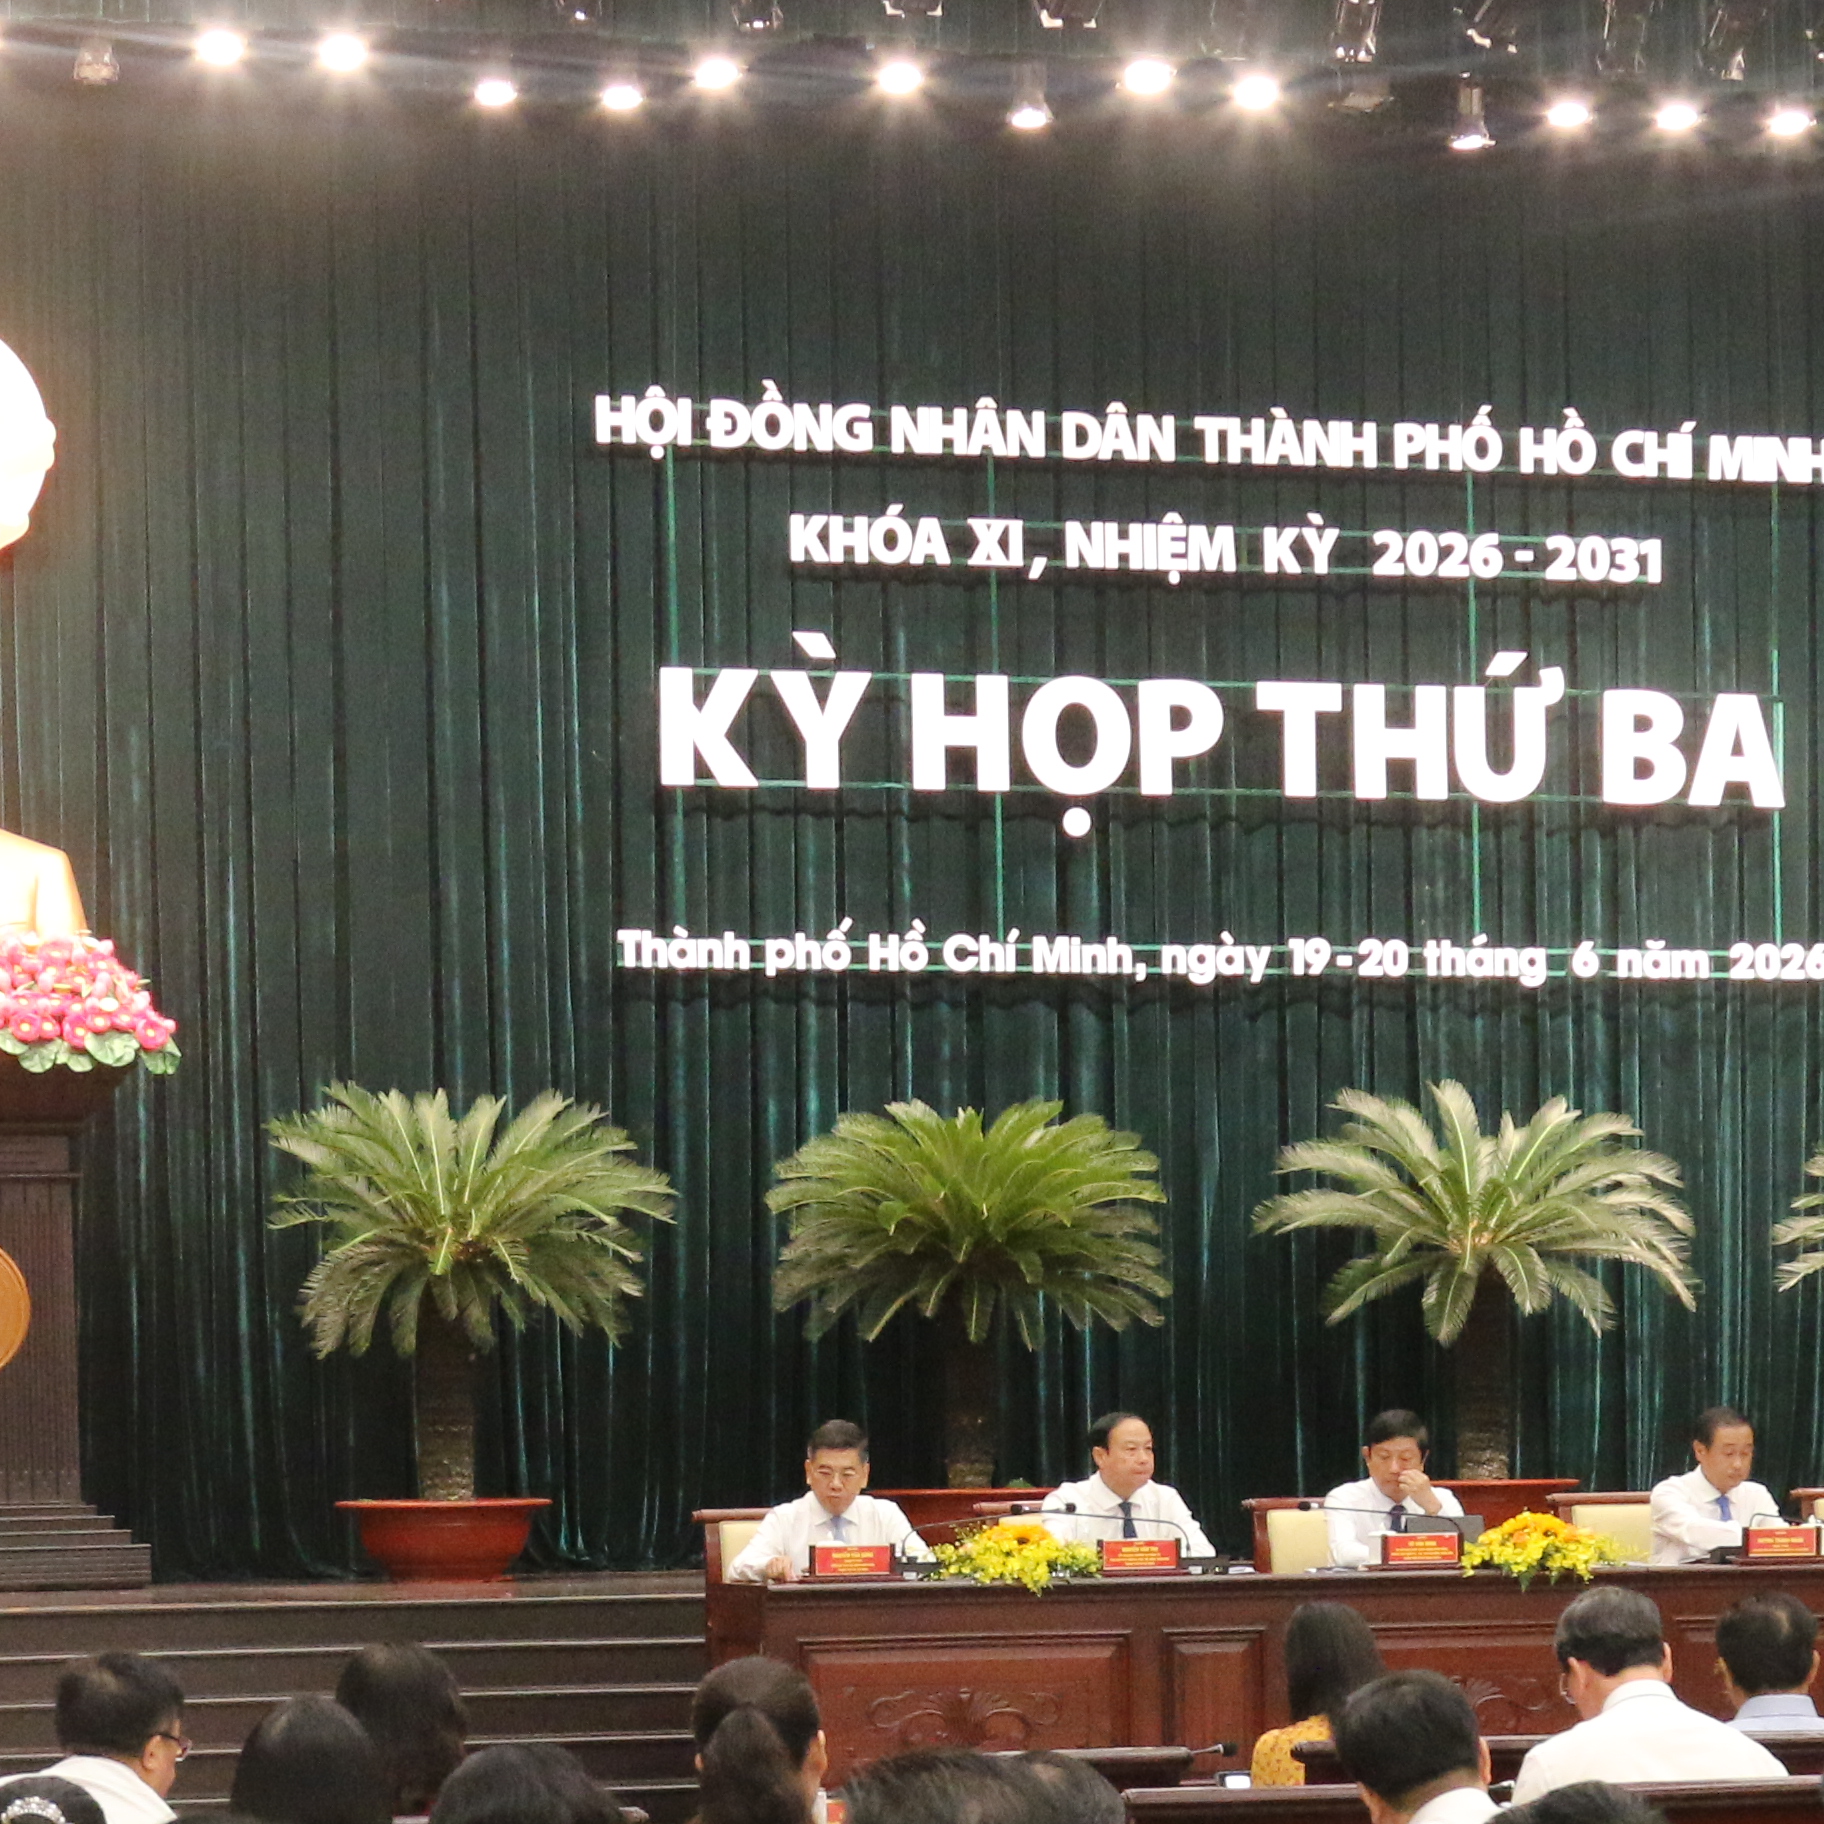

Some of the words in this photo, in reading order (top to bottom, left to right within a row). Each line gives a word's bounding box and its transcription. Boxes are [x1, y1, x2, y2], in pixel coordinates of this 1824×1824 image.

[594, 385, 693, 460] HỘI
[705, 379, 874, 453] ĐỒNG
[889, 397, 1047, 459] NHÂN
[1061, 402, 1177, 463] DÂN
[1193, 407, 1379, 469] THÀNH
[1392, 404, 1504, 473] PHỐ
[1518, 407, 1598, 476] HỒ
[1610, 421, 1698, 480] CHÍ
[789, 504, 952, 566] KHÓA
[1064, 511, 1238, 585] NHIỆM
[1262, 511, 1341, 575] KỲ
[658, 631, 873, 790] KỲ
[910, 672, 1225, 838] HỌP
[1255, 650, 1566, 804] THỨ
[1601, 688, 1787, 809] BA
[616, 924, 752, 971] Thành
[763, 916, 854, 977] phố
[867, 917, 930, 973] Hồ
[941, 927, 1021, 973] Chí
[1031, 935, 1148, 982] Minh,
[1160, 930, 1273, 986] ngày
[1421, 932, 1549, 988] tháng
[1570, 939, 1601, 979] 6
[1610, 938, 1712, 980] năm
